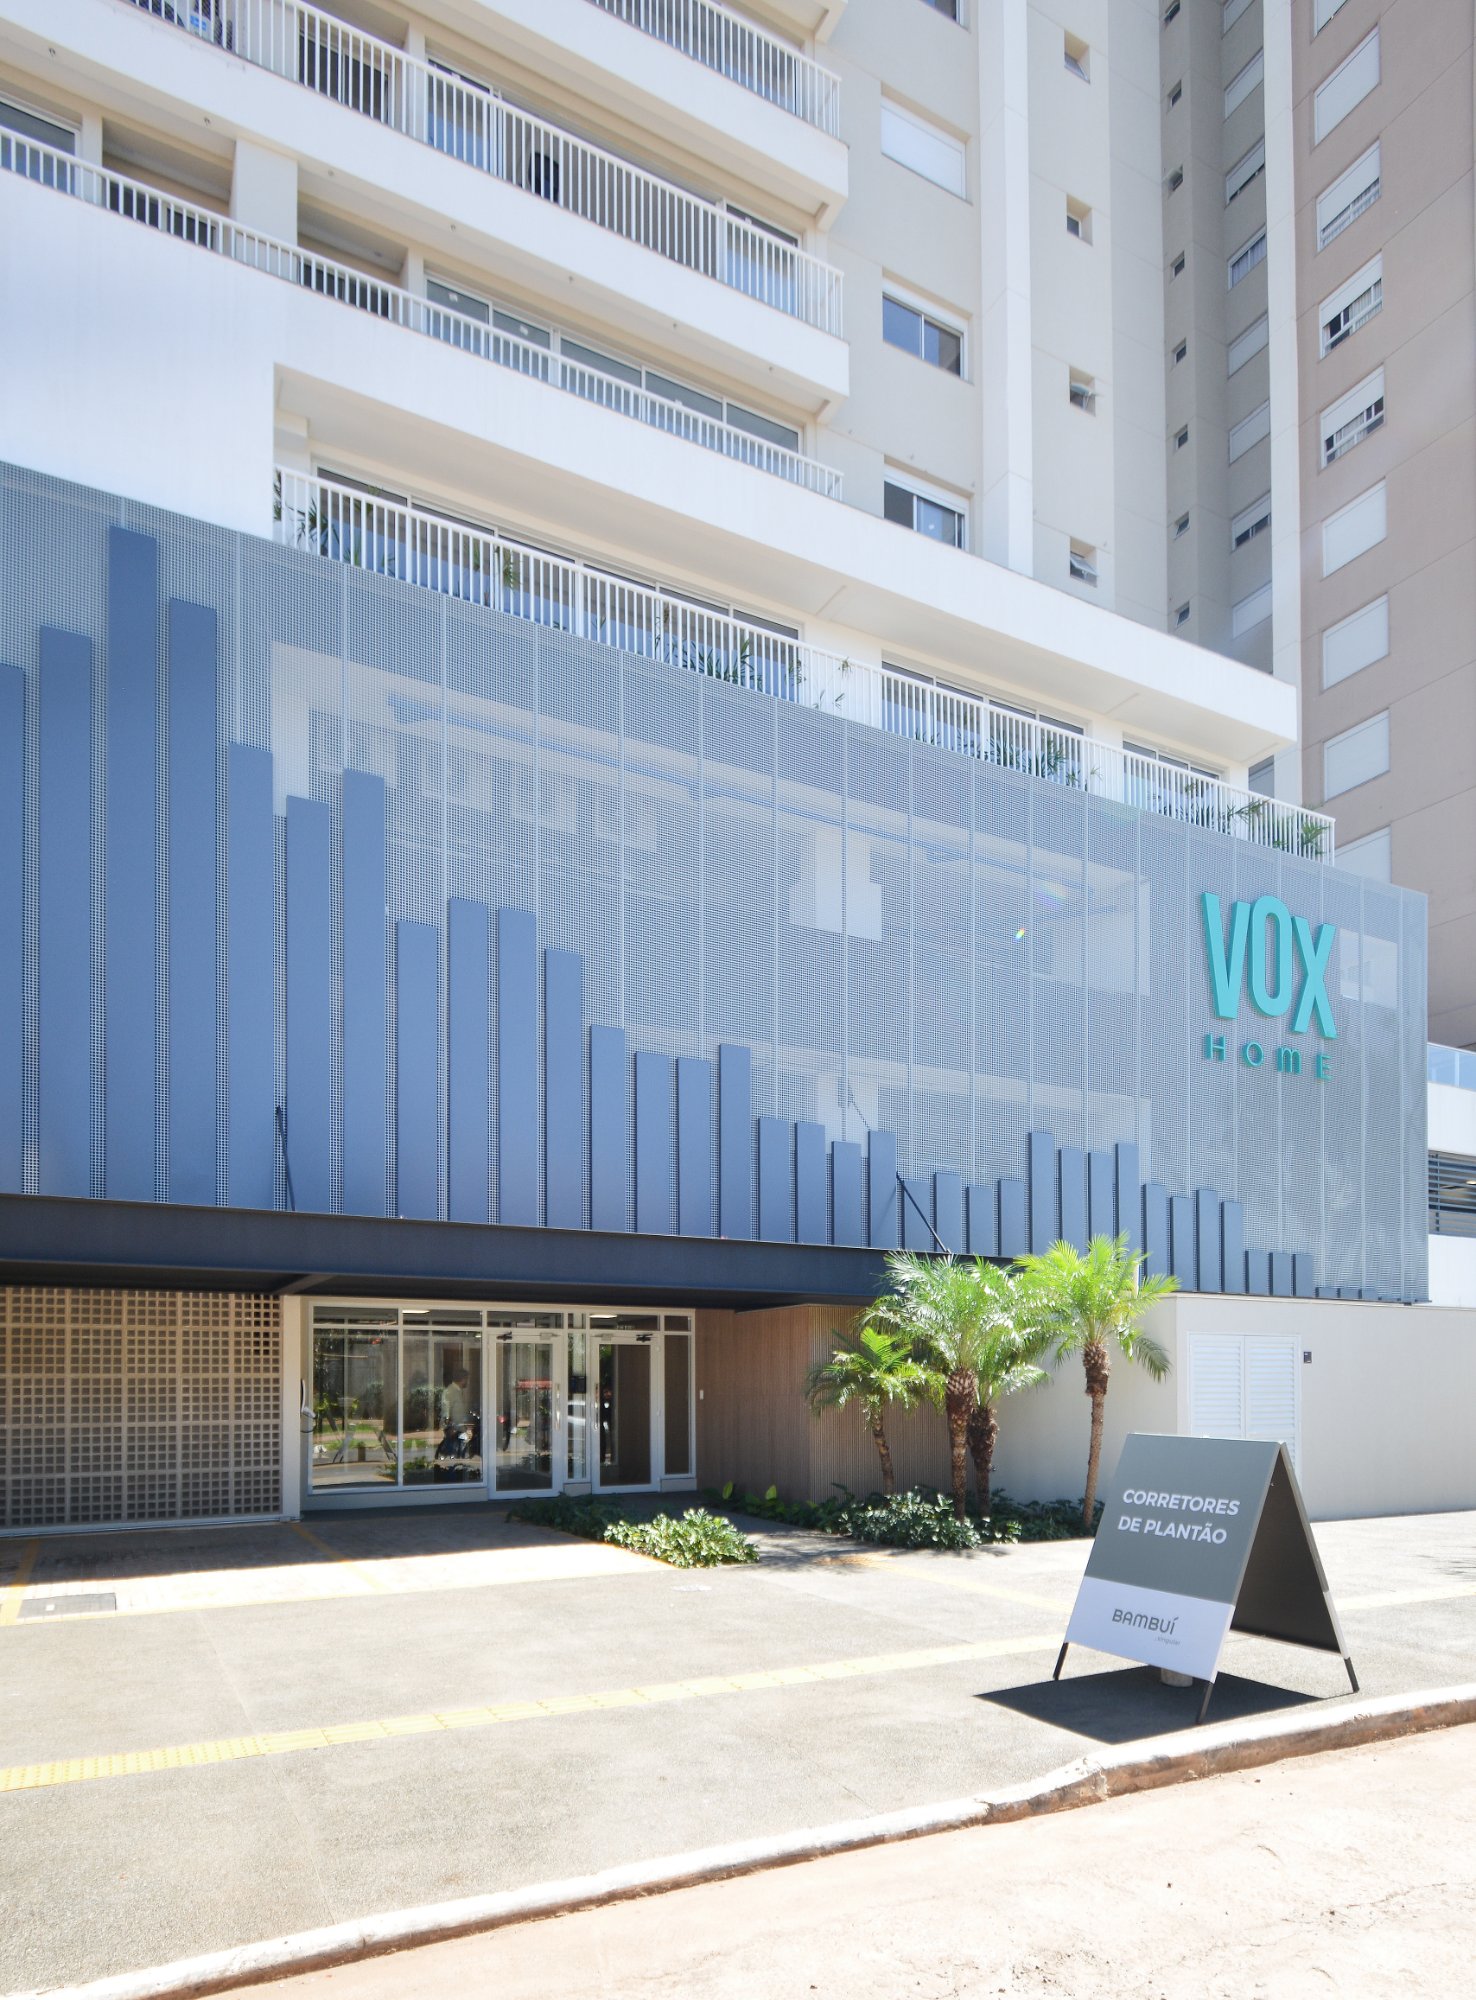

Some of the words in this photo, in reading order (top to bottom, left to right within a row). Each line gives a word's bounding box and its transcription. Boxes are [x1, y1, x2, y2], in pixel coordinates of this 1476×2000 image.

[1201, 892, 1338, 1039] VOX
[1122, 1489, 1240, 1516] CORRETORES
[1117, 1516, 1142, 1532] DE
[1143, 1519, 1227, 1544] PLANTÃO
[1112, 1608, 1179, 1635] BAMBUÍ
